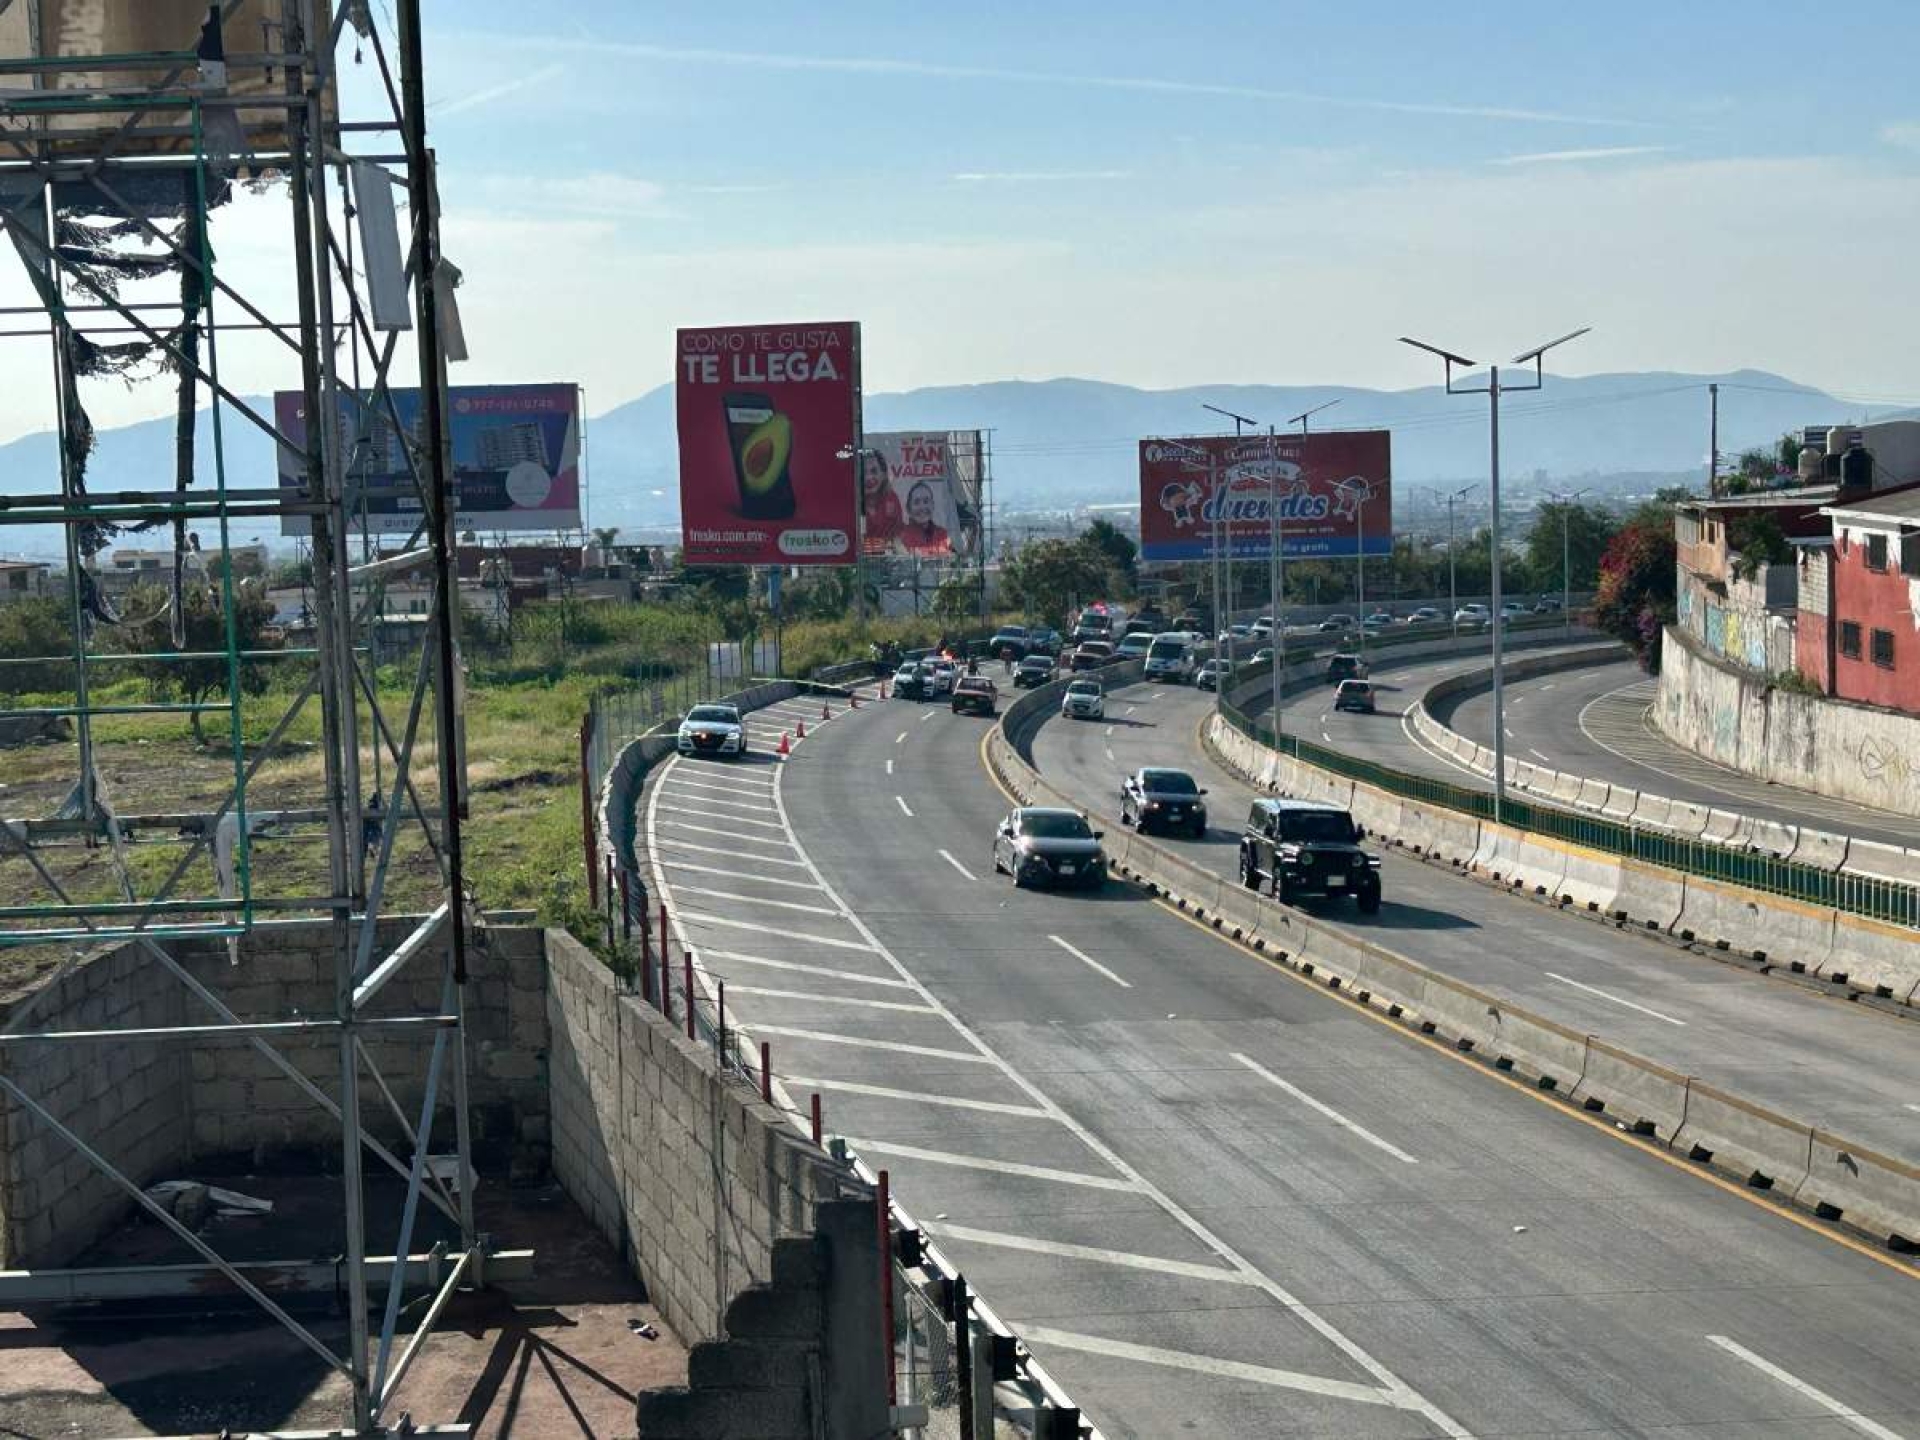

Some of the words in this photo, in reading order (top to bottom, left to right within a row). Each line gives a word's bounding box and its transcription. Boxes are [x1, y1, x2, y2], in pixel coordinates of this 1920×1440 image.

[682, 333, 744, 352] COMO
[752, 332, 771, 350] TE
[779, 331, 841, 348] GUSTA
[682, 354, 720, 384] TE
[901, 447, 945, 462] TAN
[891, 463, 946, 477] VALEN
